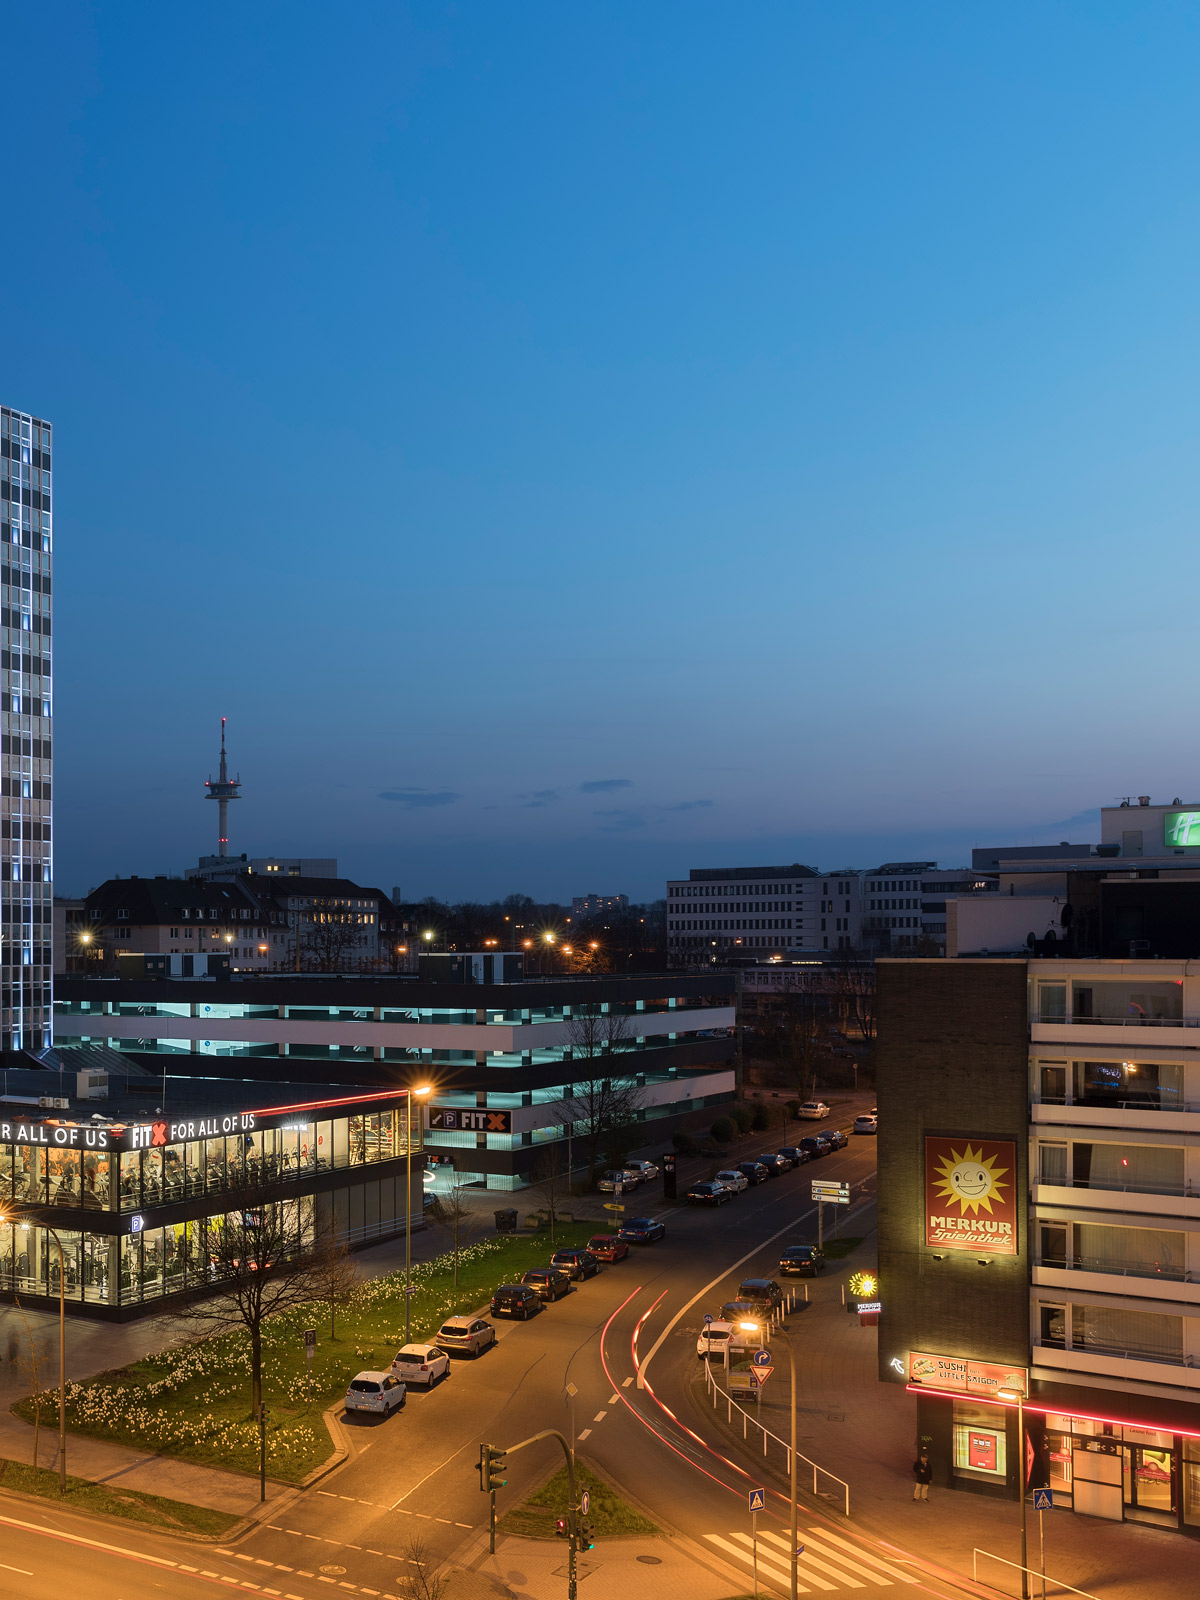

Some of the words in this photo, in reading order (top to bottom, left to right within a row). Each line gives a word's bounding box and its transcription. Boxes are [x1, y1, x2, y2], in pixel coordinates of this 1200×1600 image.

[132, 1122, 167, 1149] FITX
[170, 1123, 195, 1141] FOR
[198, 1119, 219, 1137] ALL
[222, 1116, 238, 1132] OF
[241, 1113, 255, 1130] US
[461, 1112, 506, 1131] FITX
[17, 1125, 48, 1143] ALL
[54, 1127, 78, 1145] OF
[85, 1129, 107, 1147] US
[930, 1215, 1013, 1235] MERKUR
[931, 1228, 1012, 1245] Spielothek
[938, 1361, 967, 1373] SUSHI
[939, 1371, 965, 1381] LITTLE
[967, 1375, 998, 1385] SAIGON
